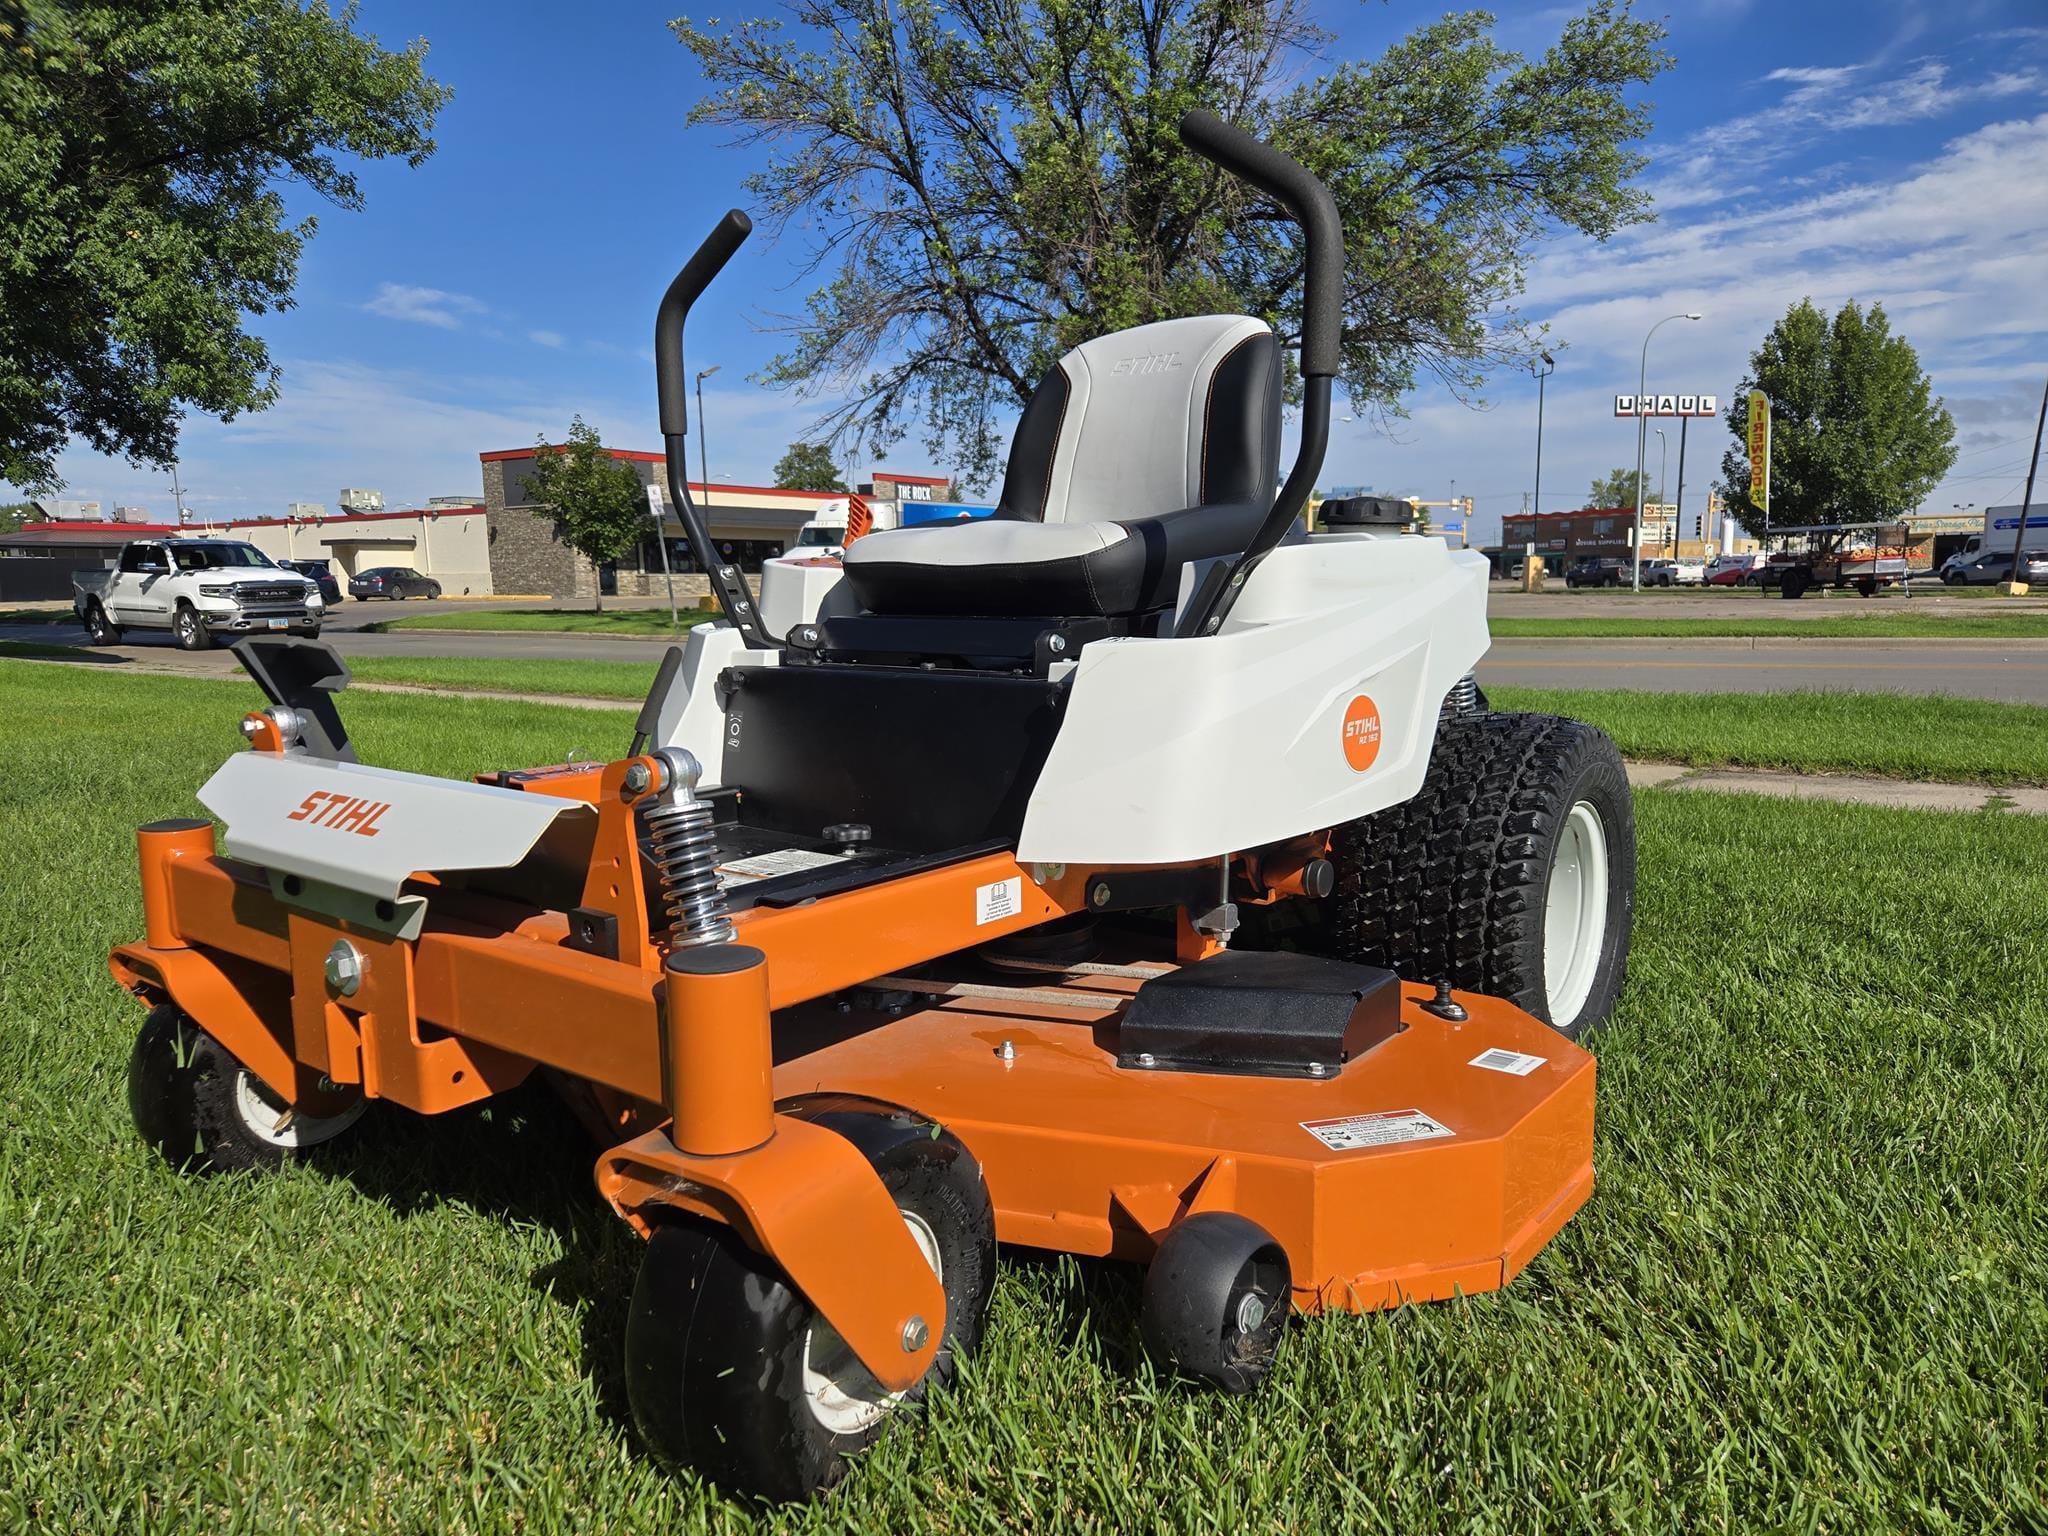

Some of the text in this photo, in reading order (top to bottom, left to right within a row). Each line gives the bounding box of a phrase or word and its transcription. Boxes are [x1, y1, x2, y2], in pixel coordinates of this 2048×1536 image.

[1110, 352, 1182, 376] STIHL
[897, 484, 931, 500] THE ROCK
[1345, 716, 1379, 738] STIHL
[287, 790, 392, 837] STIHL
